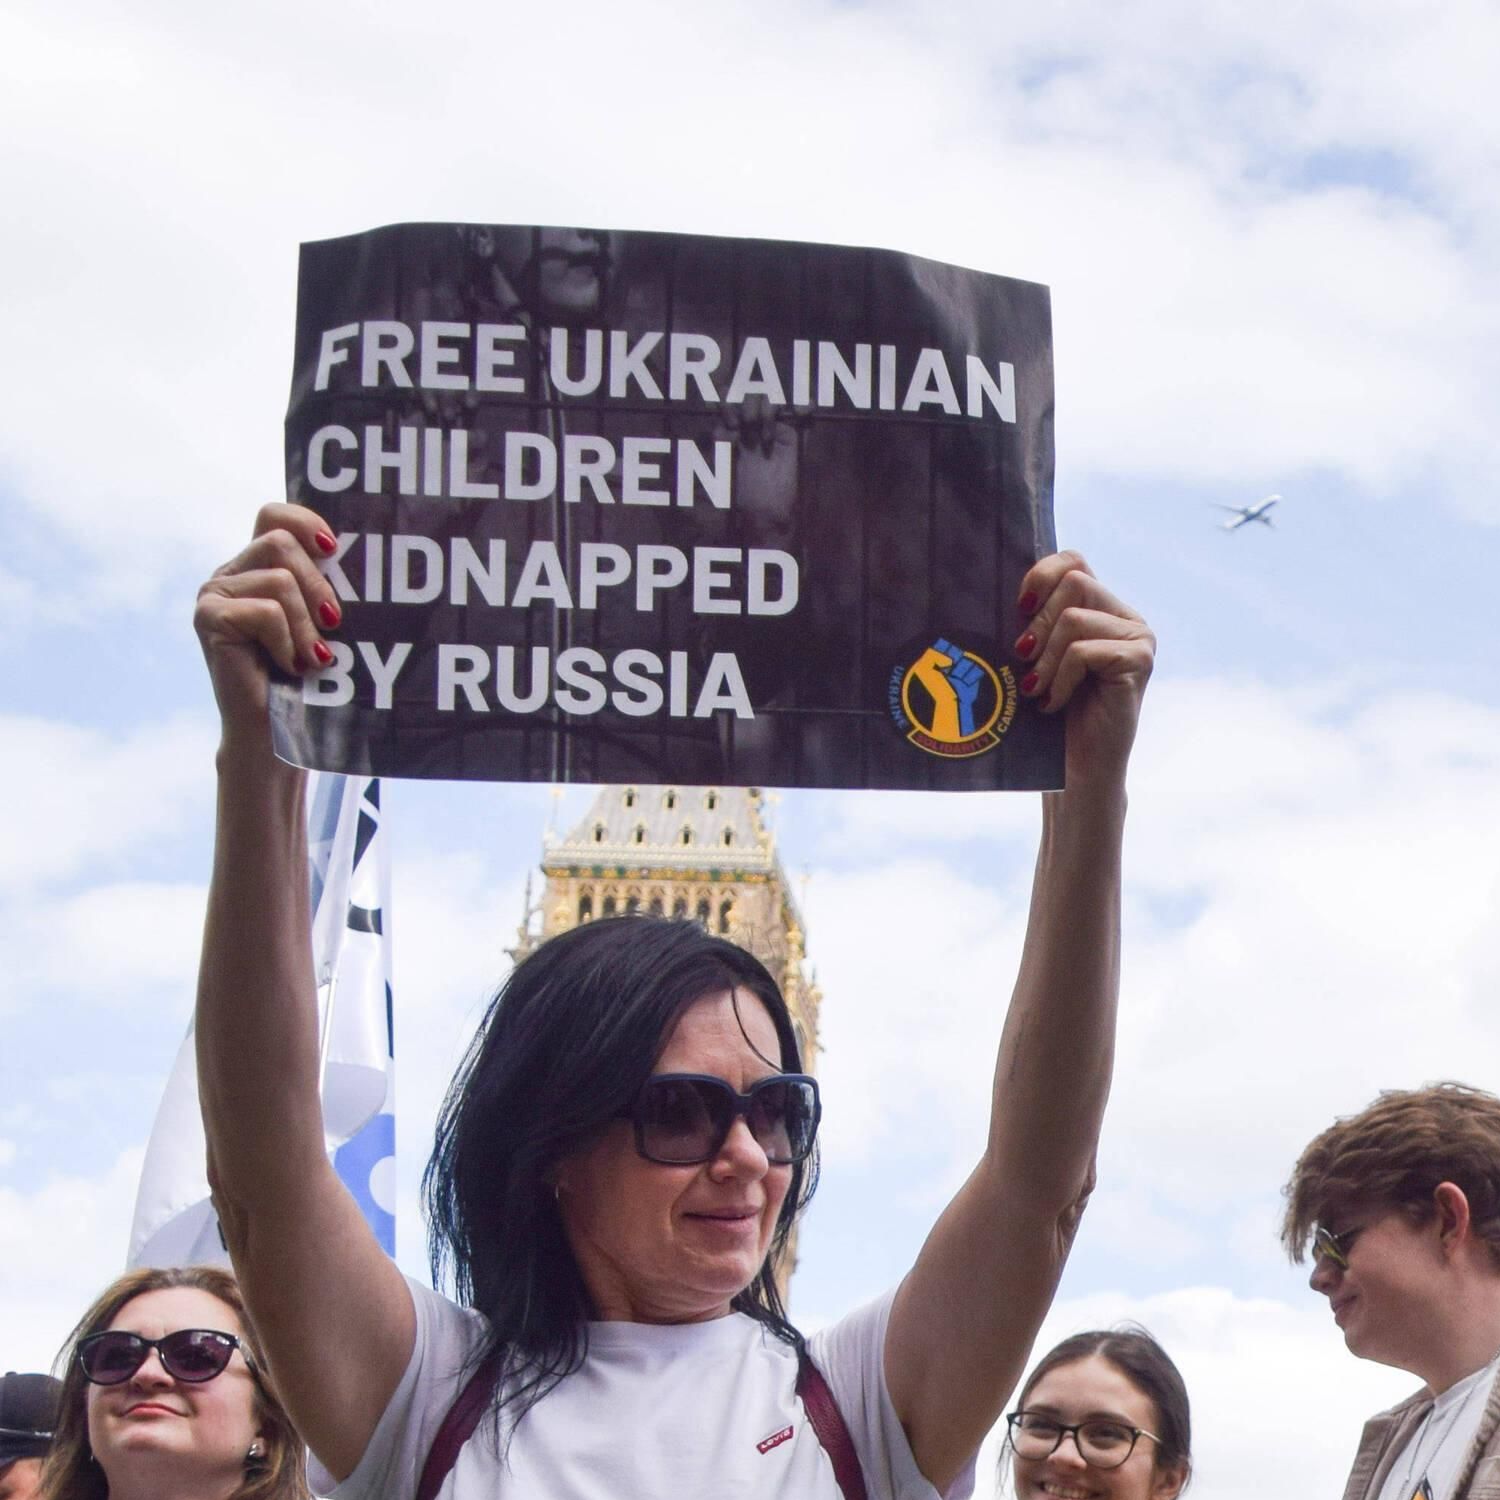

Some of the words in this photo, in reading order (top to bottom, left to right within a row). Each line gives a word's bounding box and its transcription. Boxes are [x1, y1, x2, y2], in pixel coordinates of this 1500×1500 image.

[314, 321, 527, 393] FREE
[549, 326, 1018, 424] UKRAINIAN
[306, 424, 733, 509] CHILDREN
[319, 531, 800, 616] KIDNAPPED
[302, 639, 413, 710] BY
[437, 642, 755, 719] RUSSIA
[889, 666, 907, 728] UKRAINE
[996, 665, 1017, 733] CAMPAIGN
[916, 734, 989, 754] SOLIDARITY
